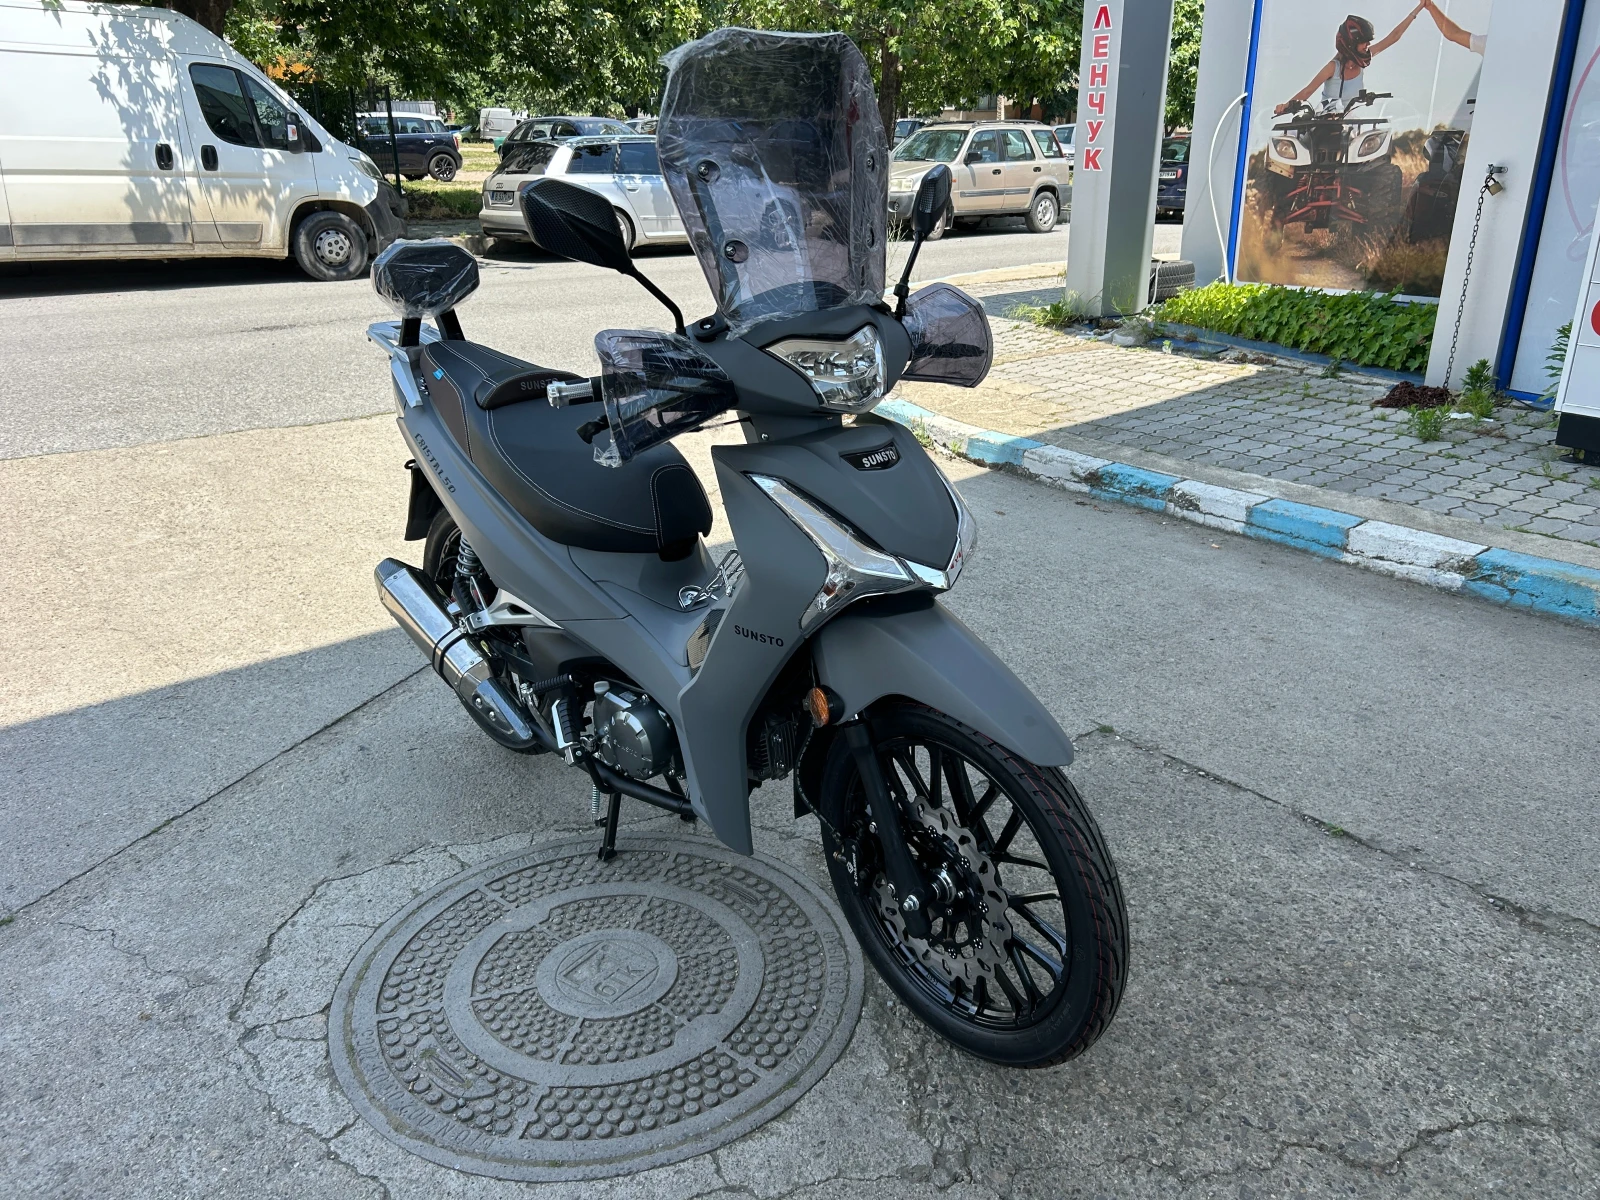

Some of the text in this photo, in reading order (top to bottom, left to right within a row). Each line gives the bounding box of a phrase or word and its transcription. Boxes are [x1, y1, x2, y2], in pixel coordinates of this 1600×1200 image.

[1083, 0, 1112, 171] ЛЕНЧУК
[862, 450, 896, 468] SUNSTO
[734, 624, 784, 648] SUNSTO
